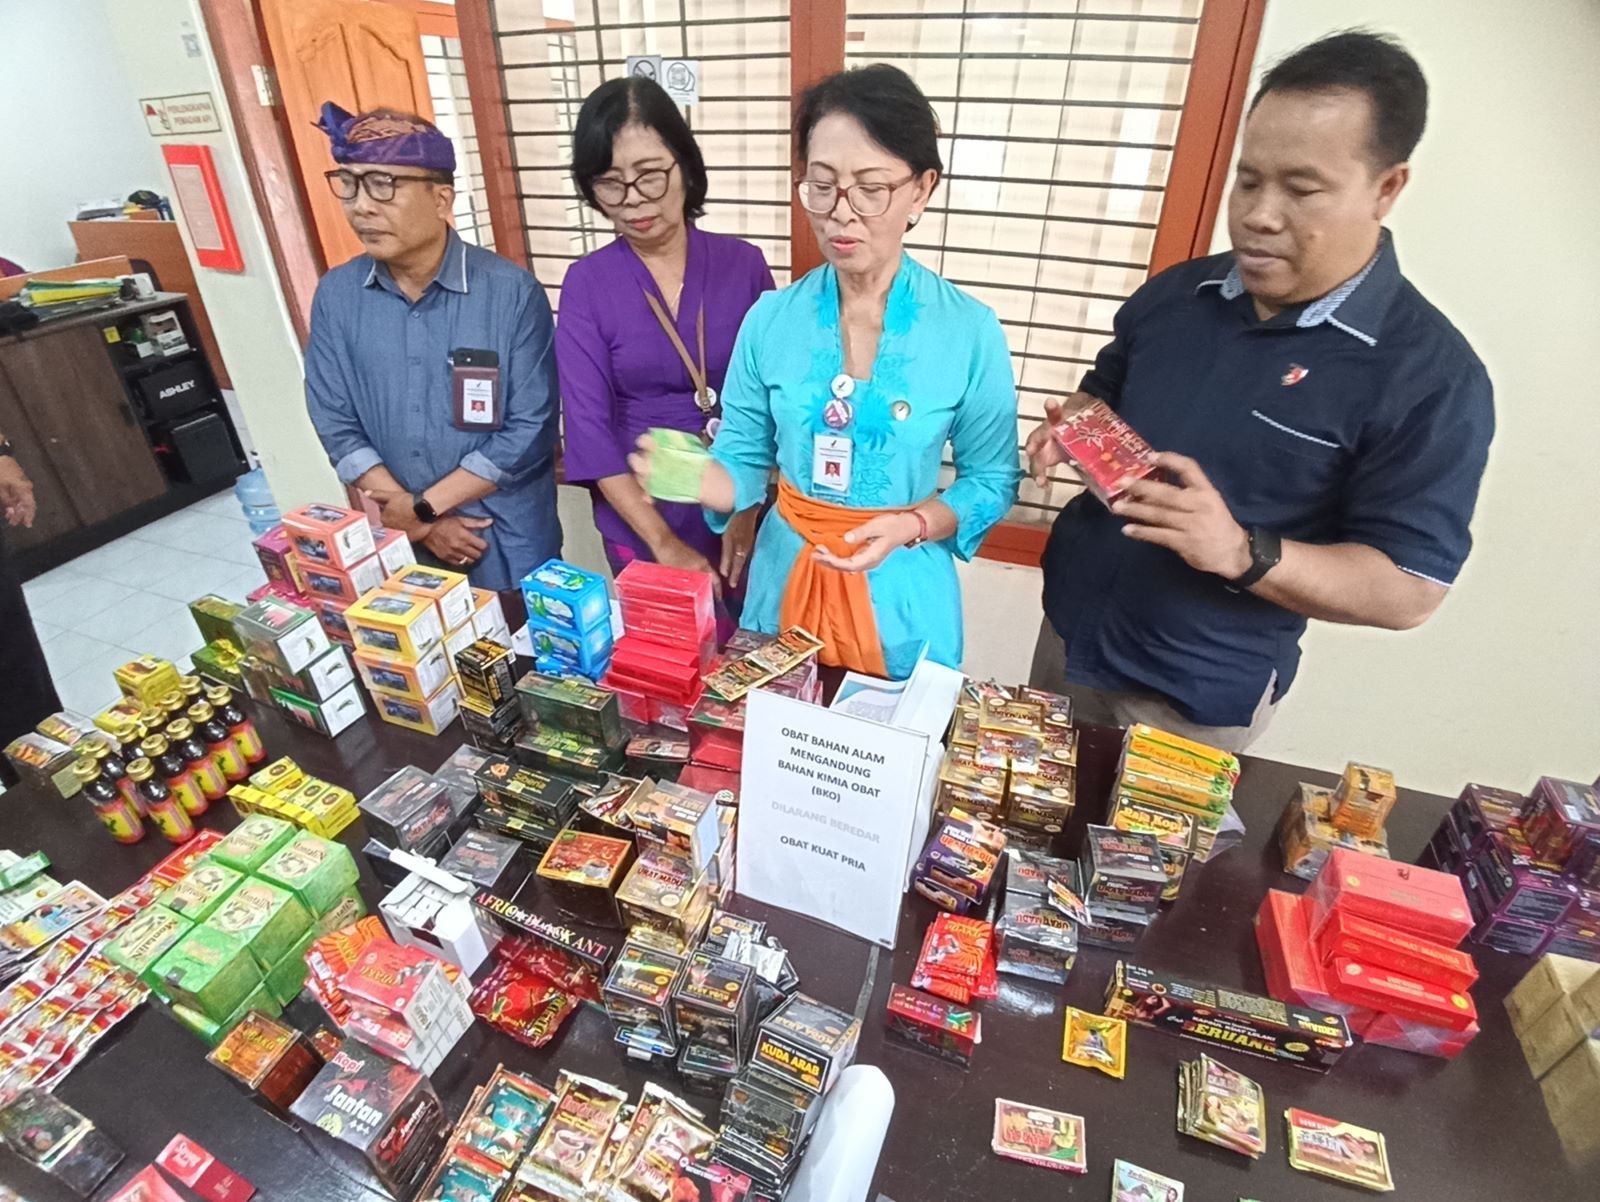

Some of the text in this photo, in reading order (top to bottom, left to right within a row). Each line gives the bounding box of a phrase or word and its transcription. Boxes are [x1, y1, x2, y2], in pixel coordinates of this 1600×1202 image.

[160, 380, 195, 400] ASHLEY
[781, 727, 885, 765] OBAT BAHAN ALAM
[790, 746, 871, 778] MENGANDUNG
[778, 759, 881, 798] BAHAN KIMIA OBAT
[811, 785, 841, 803] (BKO)
[771, 801, 881, 844] DILARANG BEREDAR
[1151, 814, 1184, 834] Kopi
[780, 835, 866, 872] OBAT KUAT PRIA
[637, 867, 684, 887] URAT MADU
[572, 937, 607, 958] ANT
[331, 1051, 365, 1074] Kopi
[761, 1041, 790, 1063] KUDA
[790, 1056, 821, 1077] ARAB
[323, 1084, 384, 1127] Jantan
